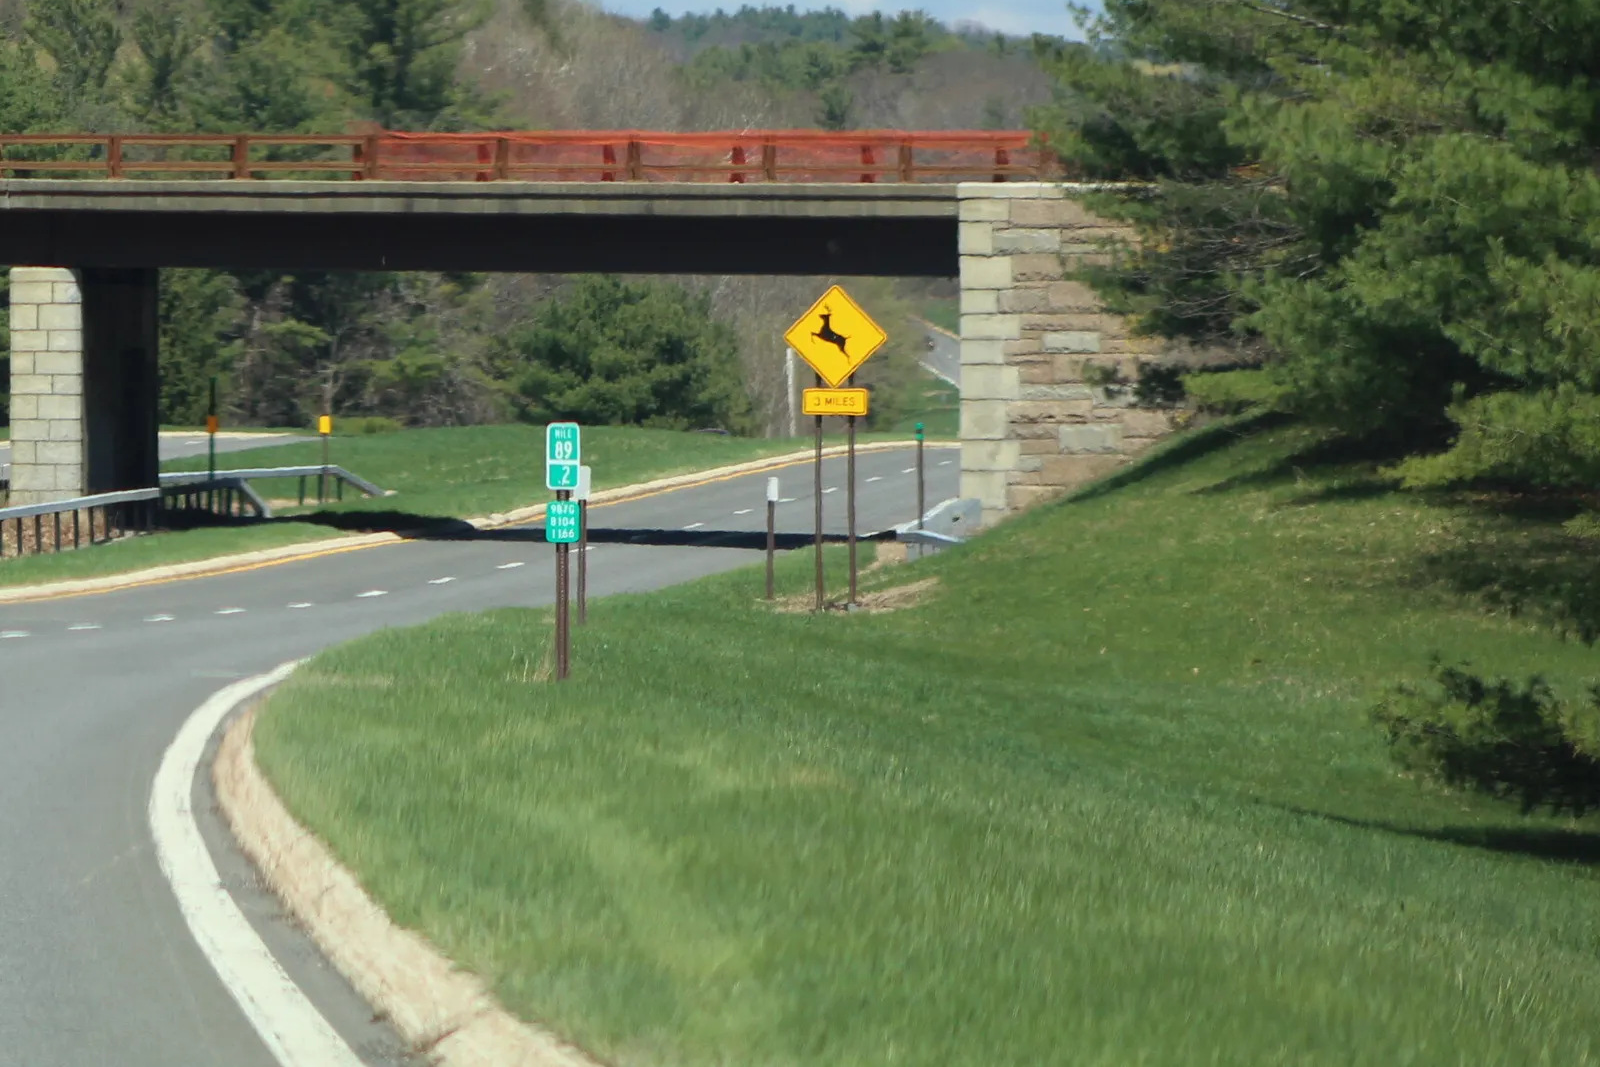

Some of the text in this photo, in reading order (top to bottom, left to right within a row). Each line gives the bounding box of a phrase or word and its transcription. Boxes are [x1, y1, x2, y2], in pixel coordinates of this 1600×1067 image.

[825, 397, 855, 407] MILES
[555, 429, 572, 439] MILE
[555, 441, 573, 459] 89
